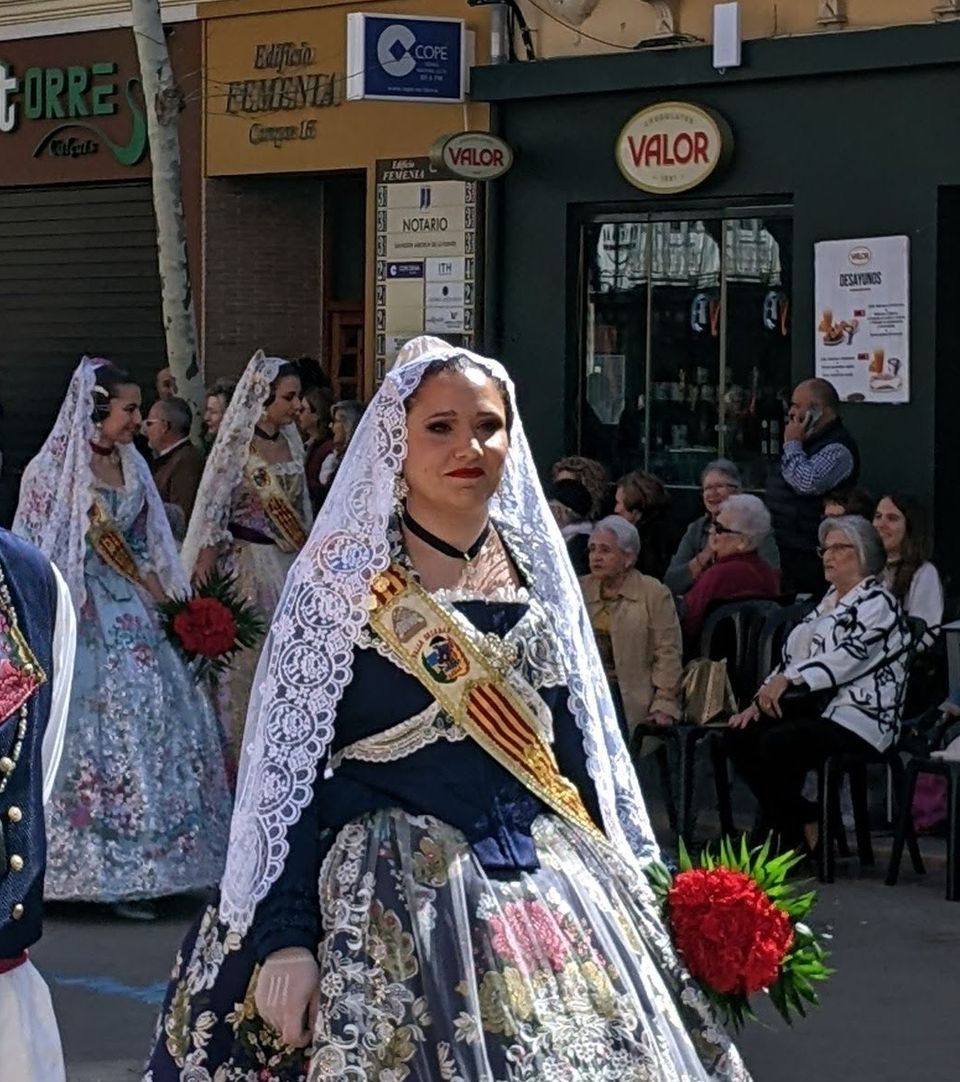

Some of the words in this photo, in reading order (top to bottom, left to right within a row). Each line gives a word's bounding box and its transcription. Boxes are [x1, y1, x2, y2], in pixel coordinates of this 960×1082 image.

[415, 45, 448, 61] COPE
[448, 147, 504, 167] VALOR
[628, 132, 709, 167] VALOR
[402, 217, 448, 232] NOTARIO
[839, 271, 882, 287] DESAYUNOS
